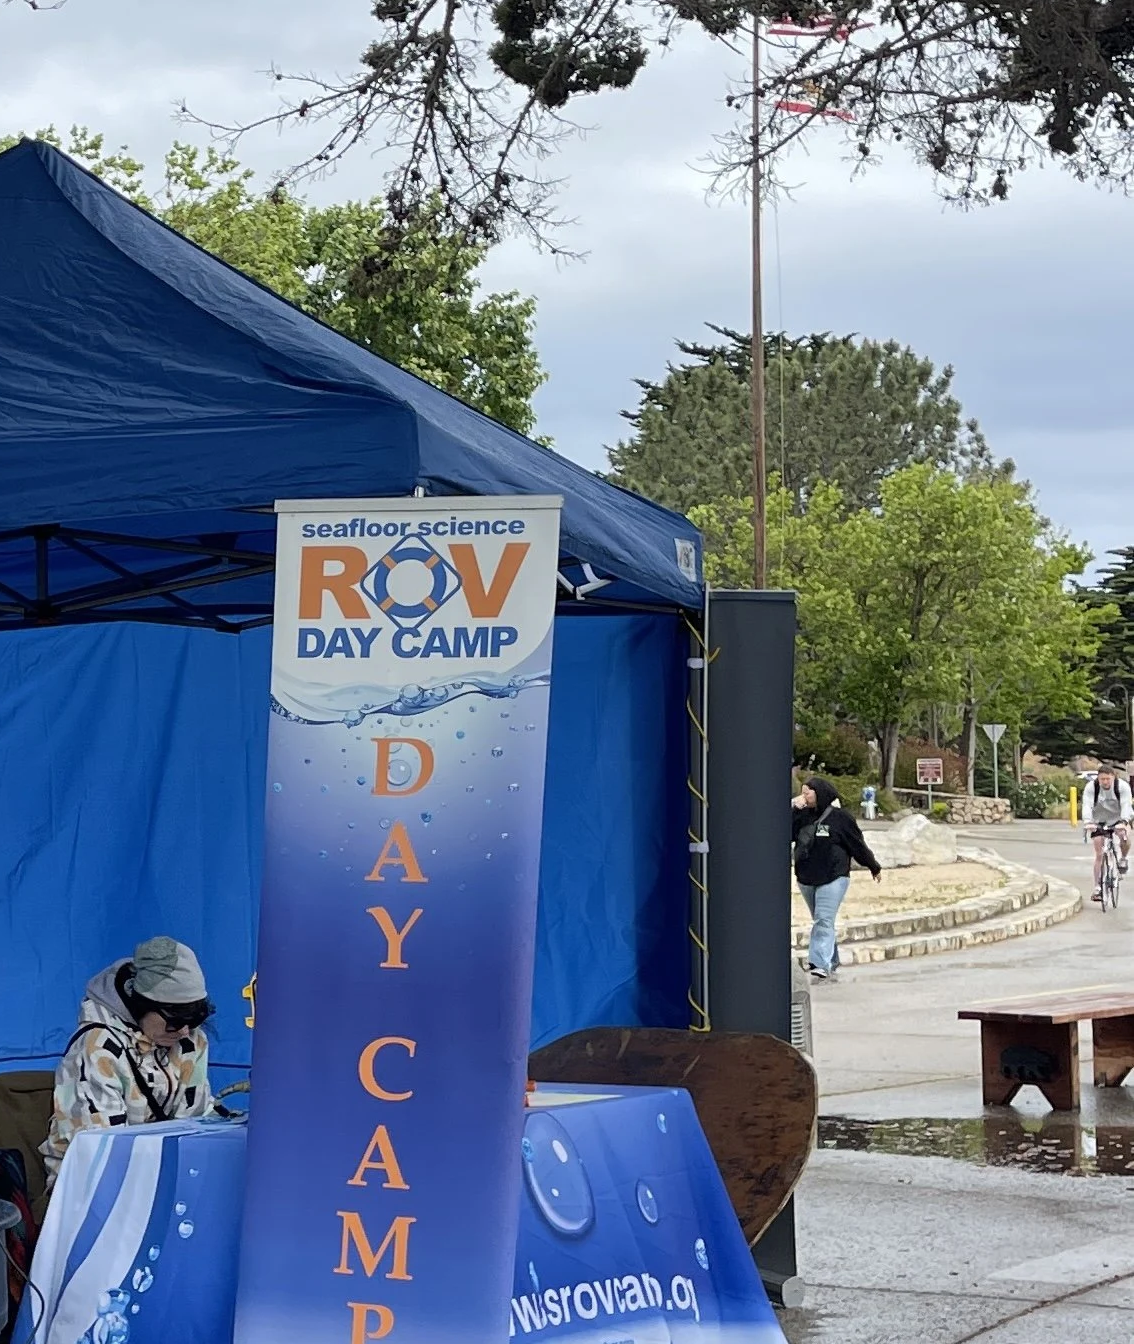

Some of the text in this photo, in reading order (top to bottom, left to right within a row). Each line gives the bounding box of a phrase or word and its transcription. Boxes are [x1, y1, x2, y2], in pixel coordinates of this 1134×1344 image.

[301, 516, 525, 538] seafloor science
[298, 542, 531, 620] ROV
[297, 626, 519, 659] DAY CAMP
